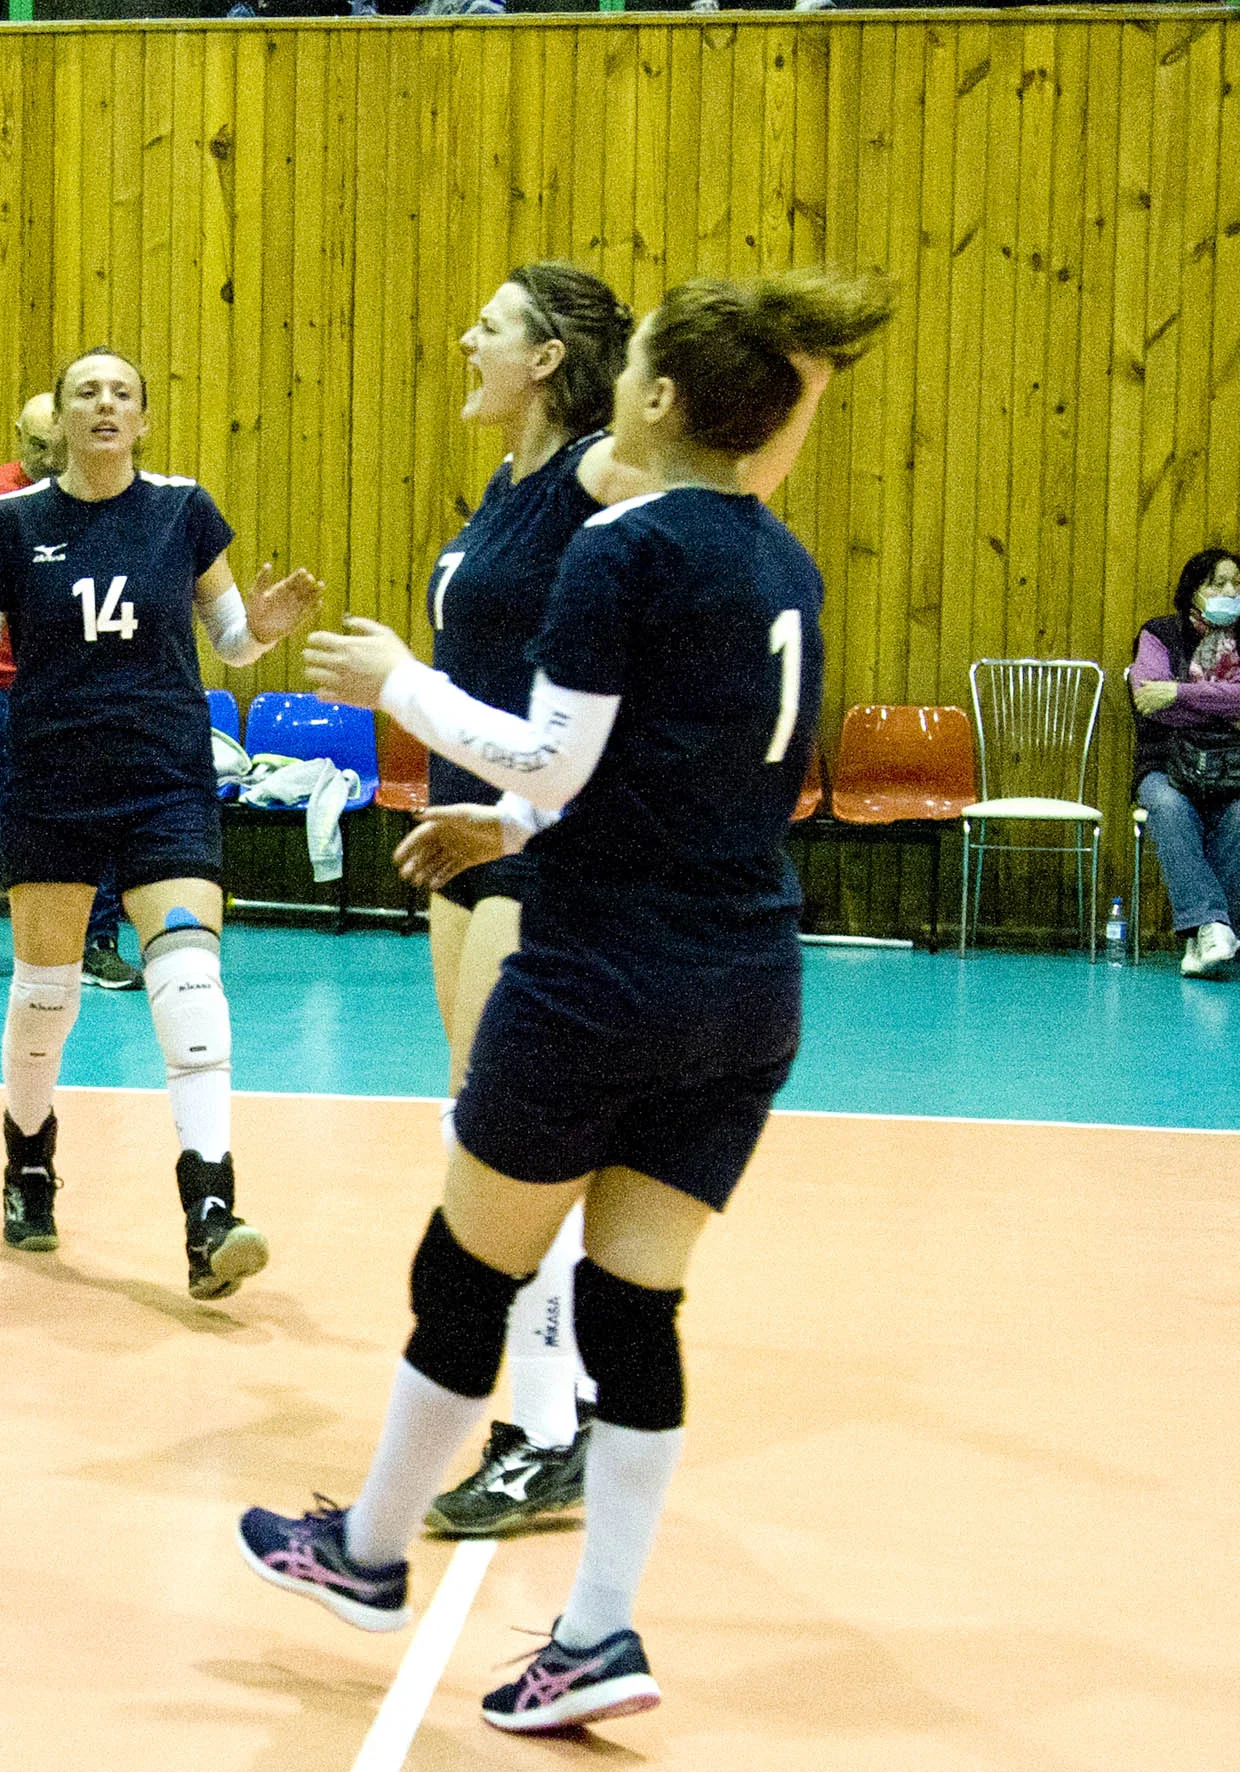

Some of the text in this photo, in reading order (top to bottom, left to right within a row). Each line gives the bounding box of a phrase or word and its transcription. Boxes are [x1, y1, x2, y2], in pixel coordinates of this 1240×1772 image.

[72, 575, 139, 642] 14
[434, 551, 465, 631] 7
[765, 608, 802, 764] 1
